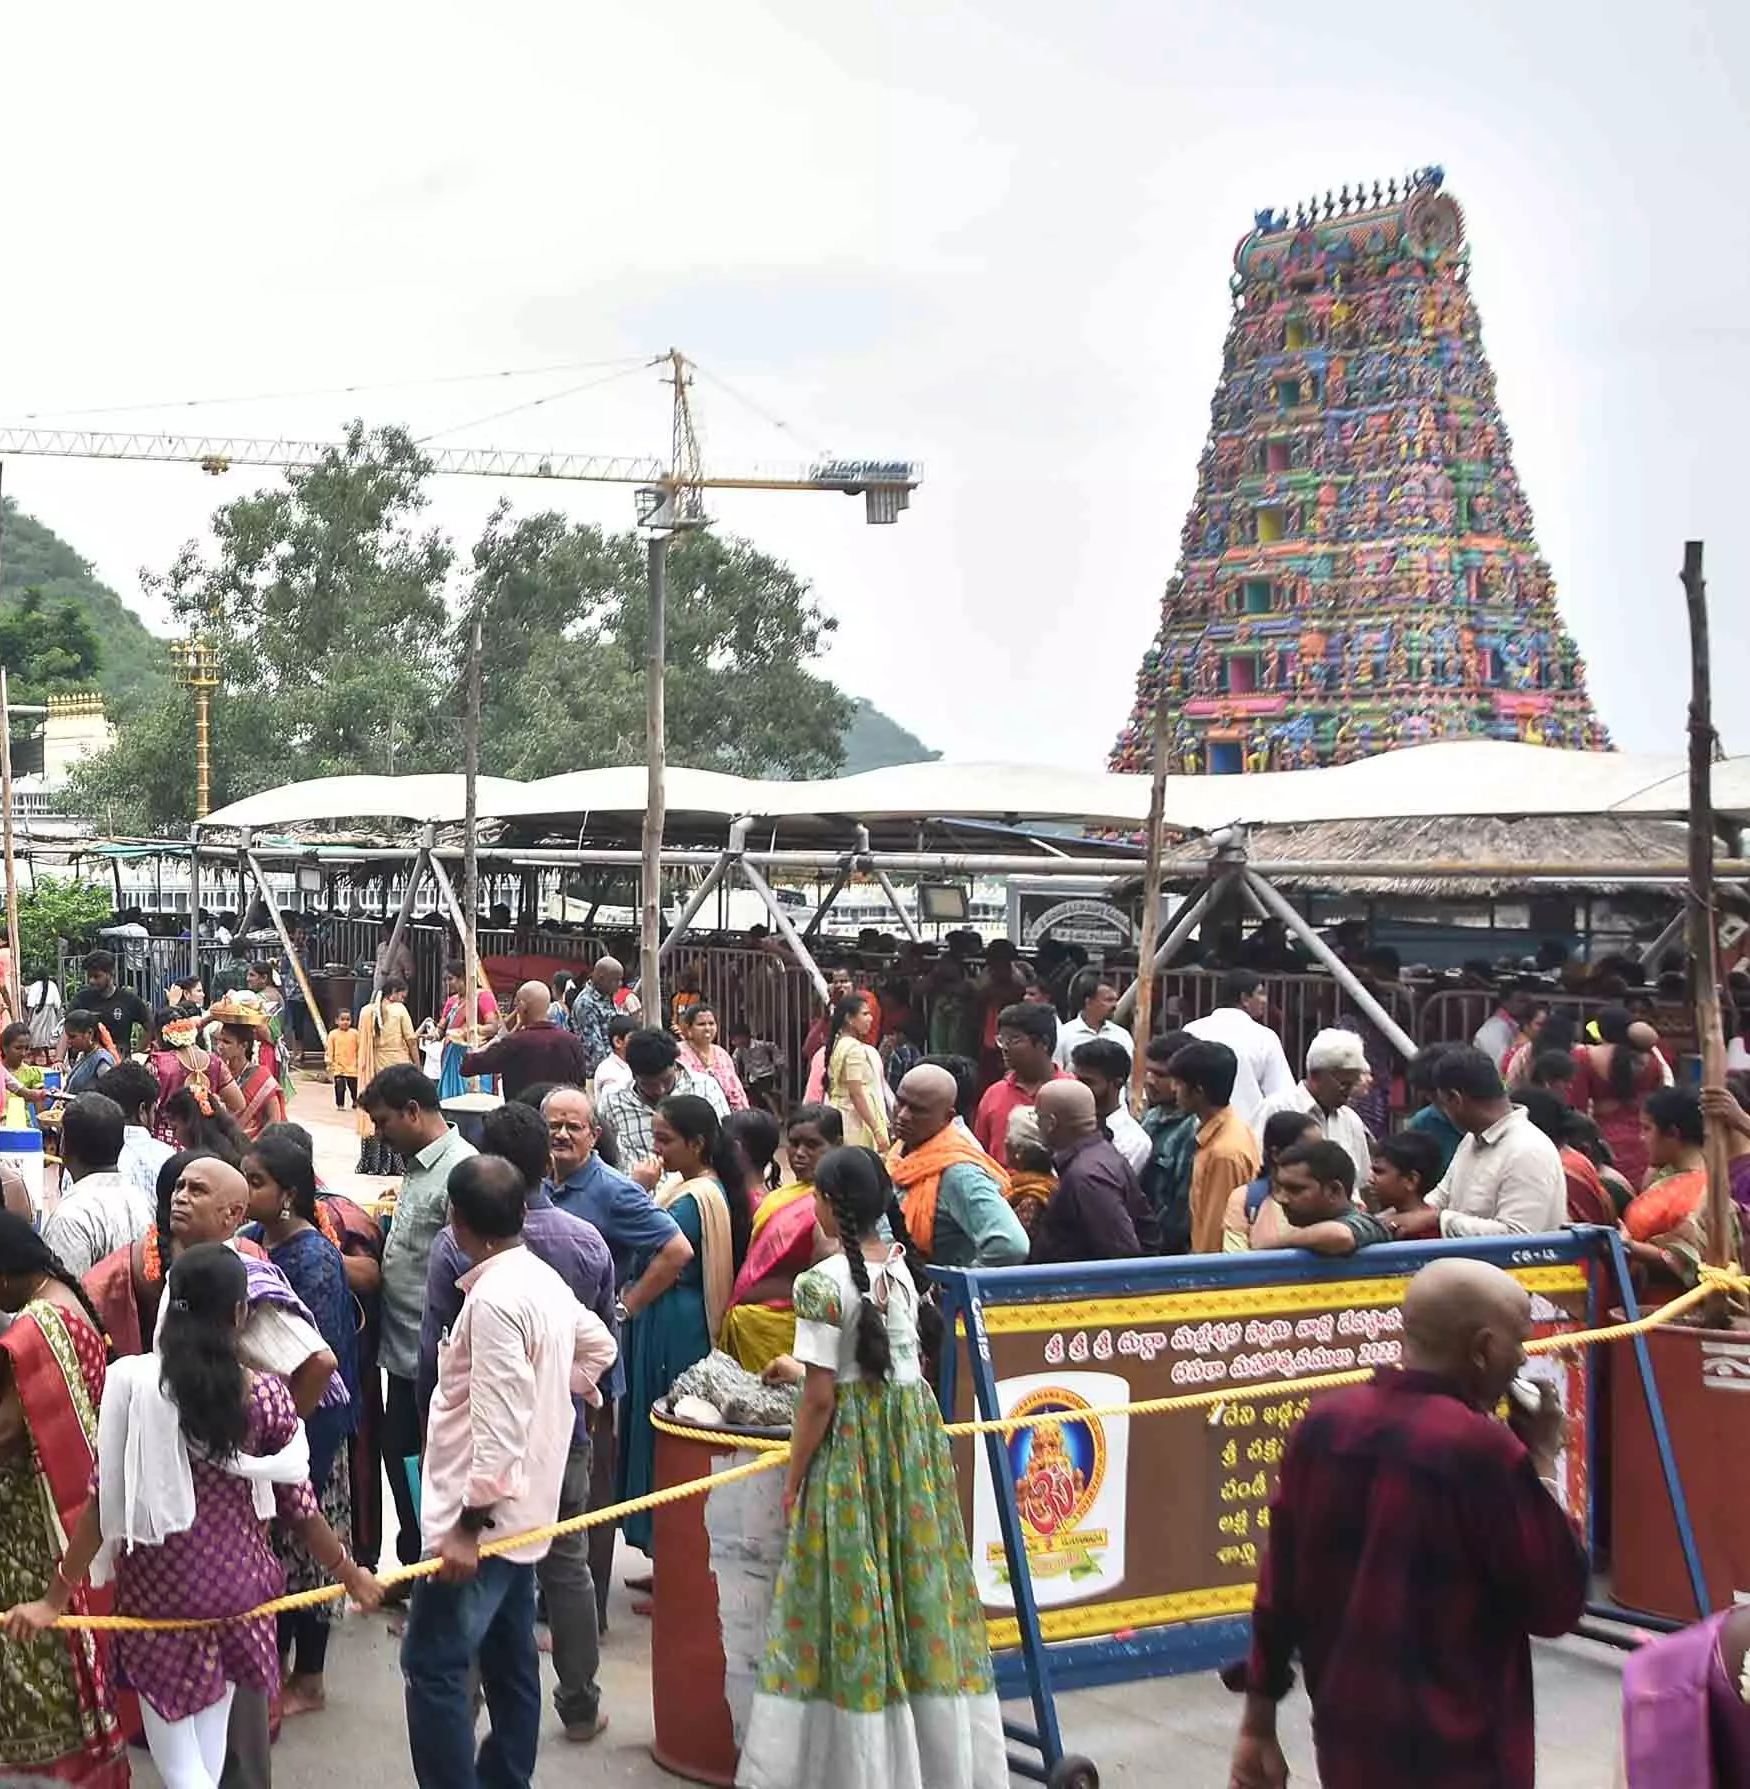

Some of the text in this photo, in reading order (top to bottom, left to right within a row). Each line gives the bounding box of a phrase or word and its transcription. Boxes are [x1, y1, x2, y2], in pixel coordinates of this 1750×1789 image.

[1045, 1333, 1065, 1364] శ్రీ
[1069, 1331, 1090, 1362] శ్రీ
[1093, 1328, 1114, 1360] శ్రీ
[1357, 1340, 1403, 1366] 2023
